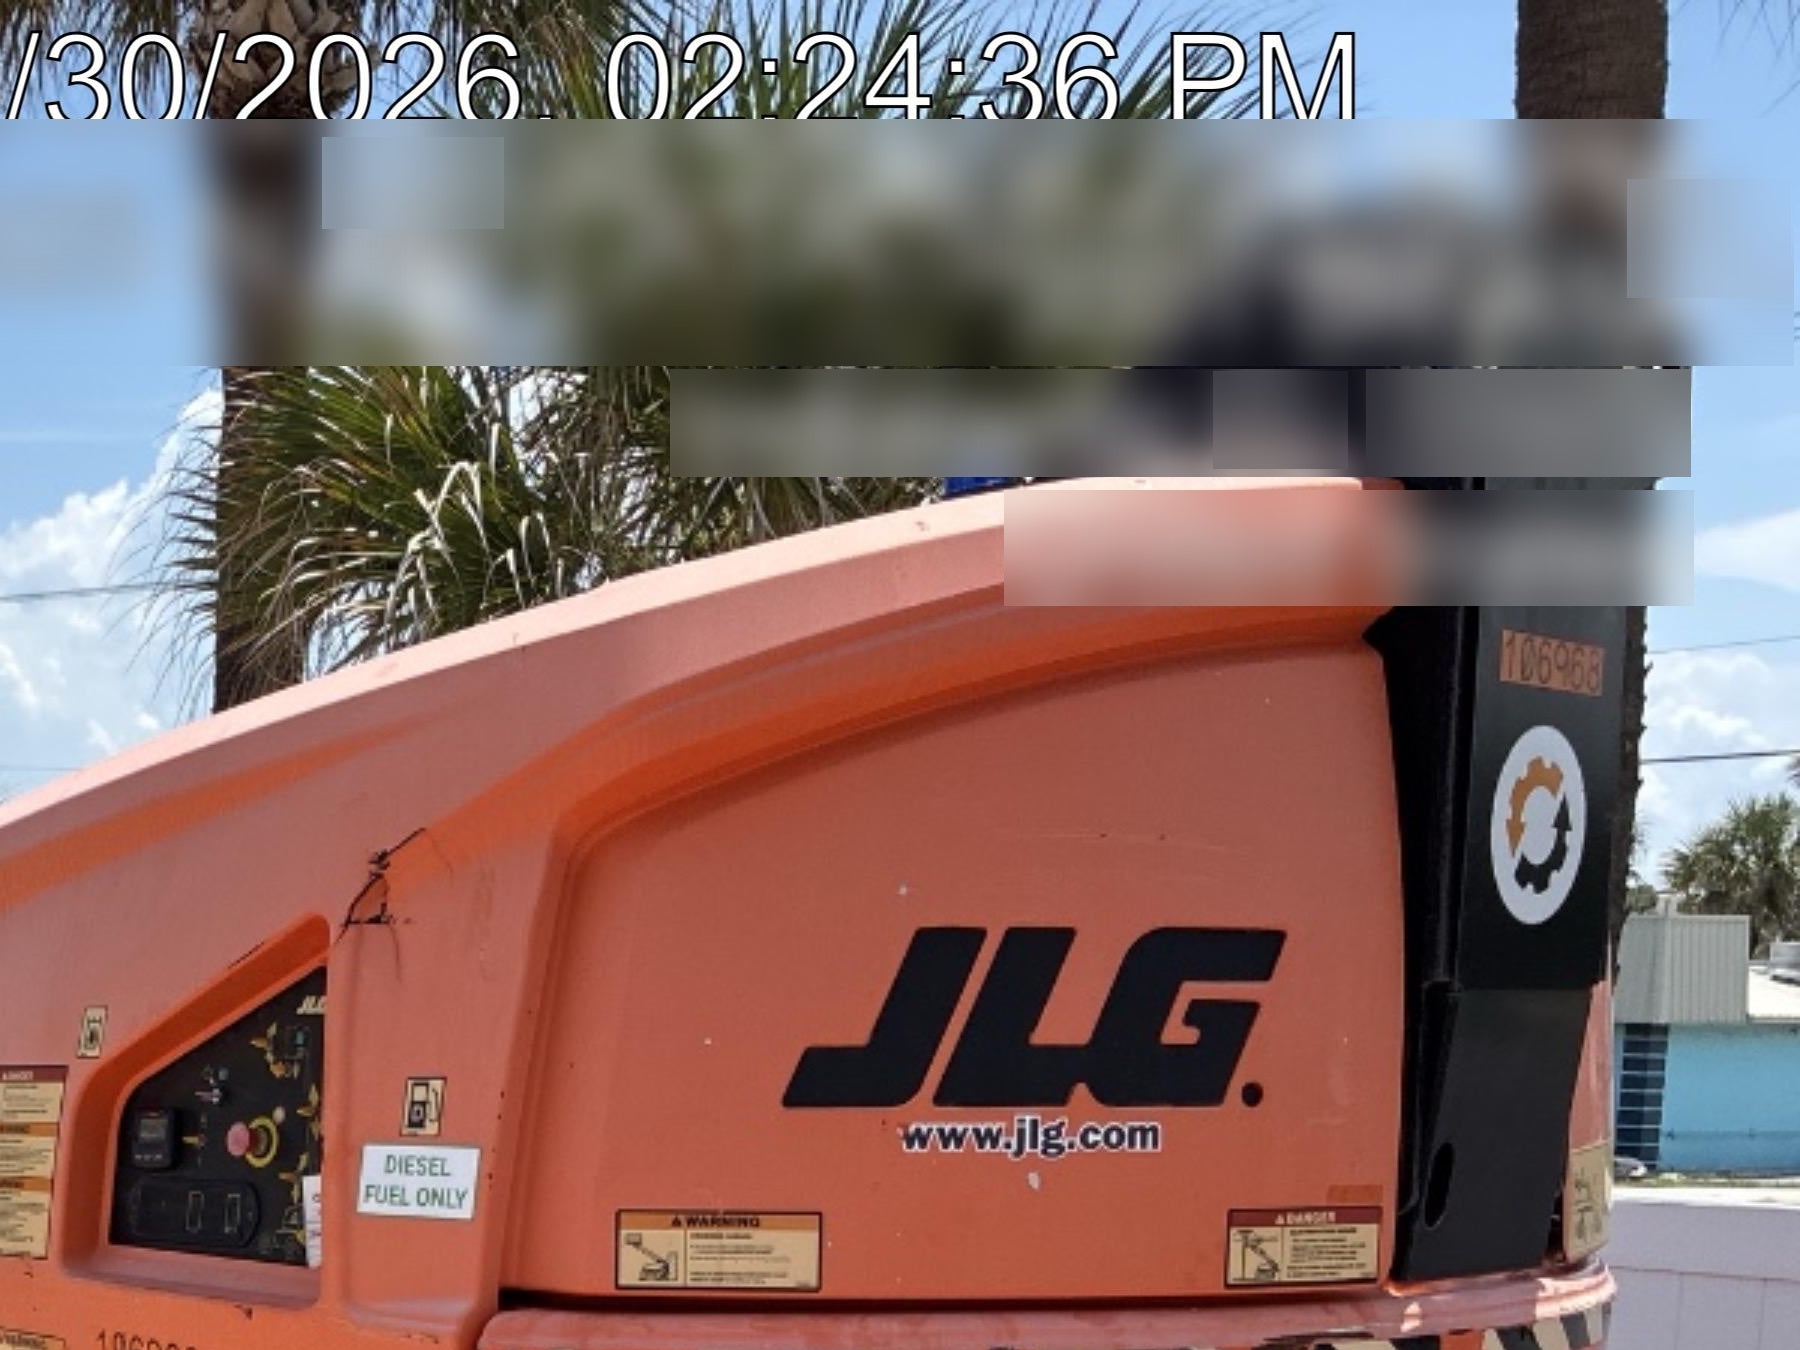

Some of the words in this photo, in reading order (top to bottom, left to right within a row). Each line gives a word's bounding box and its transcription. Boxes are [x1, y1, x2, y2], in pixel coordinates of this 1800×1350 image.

[902, 1115, 1161, 1157] www.jlg.com
[384, 1154, 452, 1178] DIESEL
[364, 1184, 409, 1207] FUEL
[416, 1186, 469, 1209] ONLY
